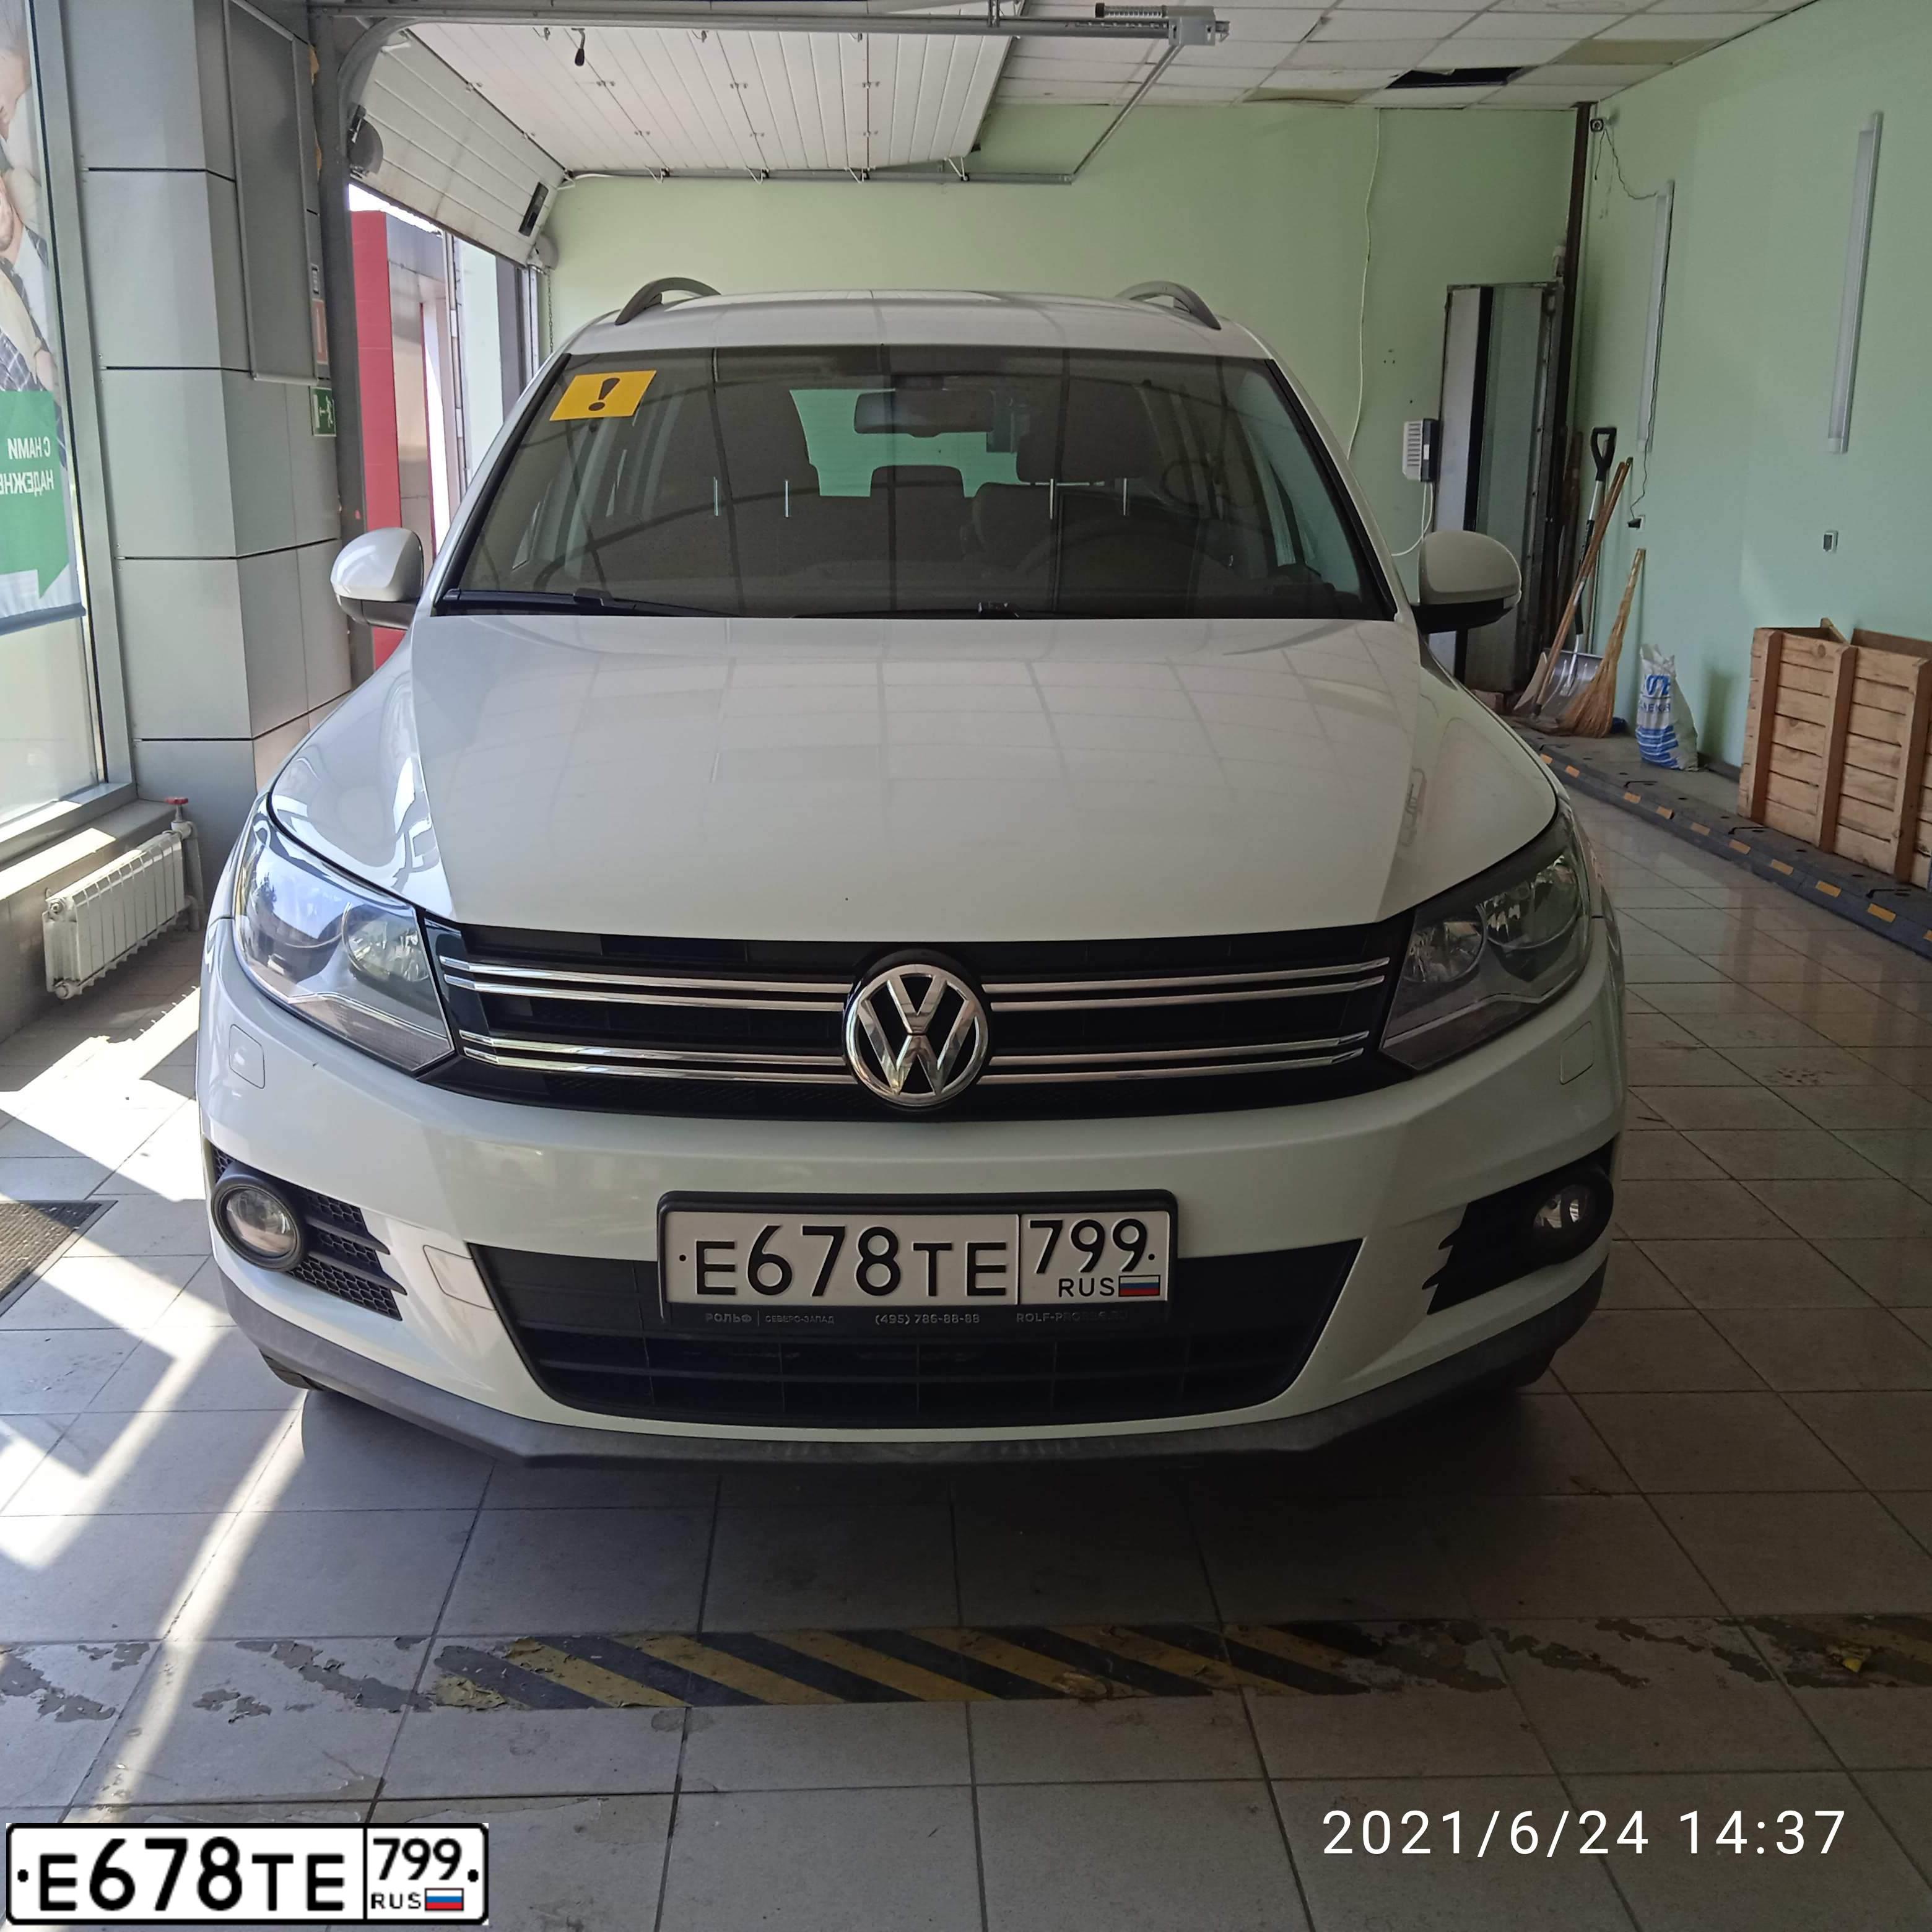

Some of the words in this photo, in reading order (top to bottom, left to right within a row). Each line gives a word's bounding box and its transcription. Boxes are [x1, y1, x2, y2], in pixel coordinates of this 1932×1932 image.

[1028, 1218, 1149, 1275] 799
[1058, 1277, 1115, 1298] RUS
[705, 1312, 753, 1323] РОЛЬФ
[874, 1313, 911, 1326] (495)
[914, 1313, 981, 1324] 786-88-88
